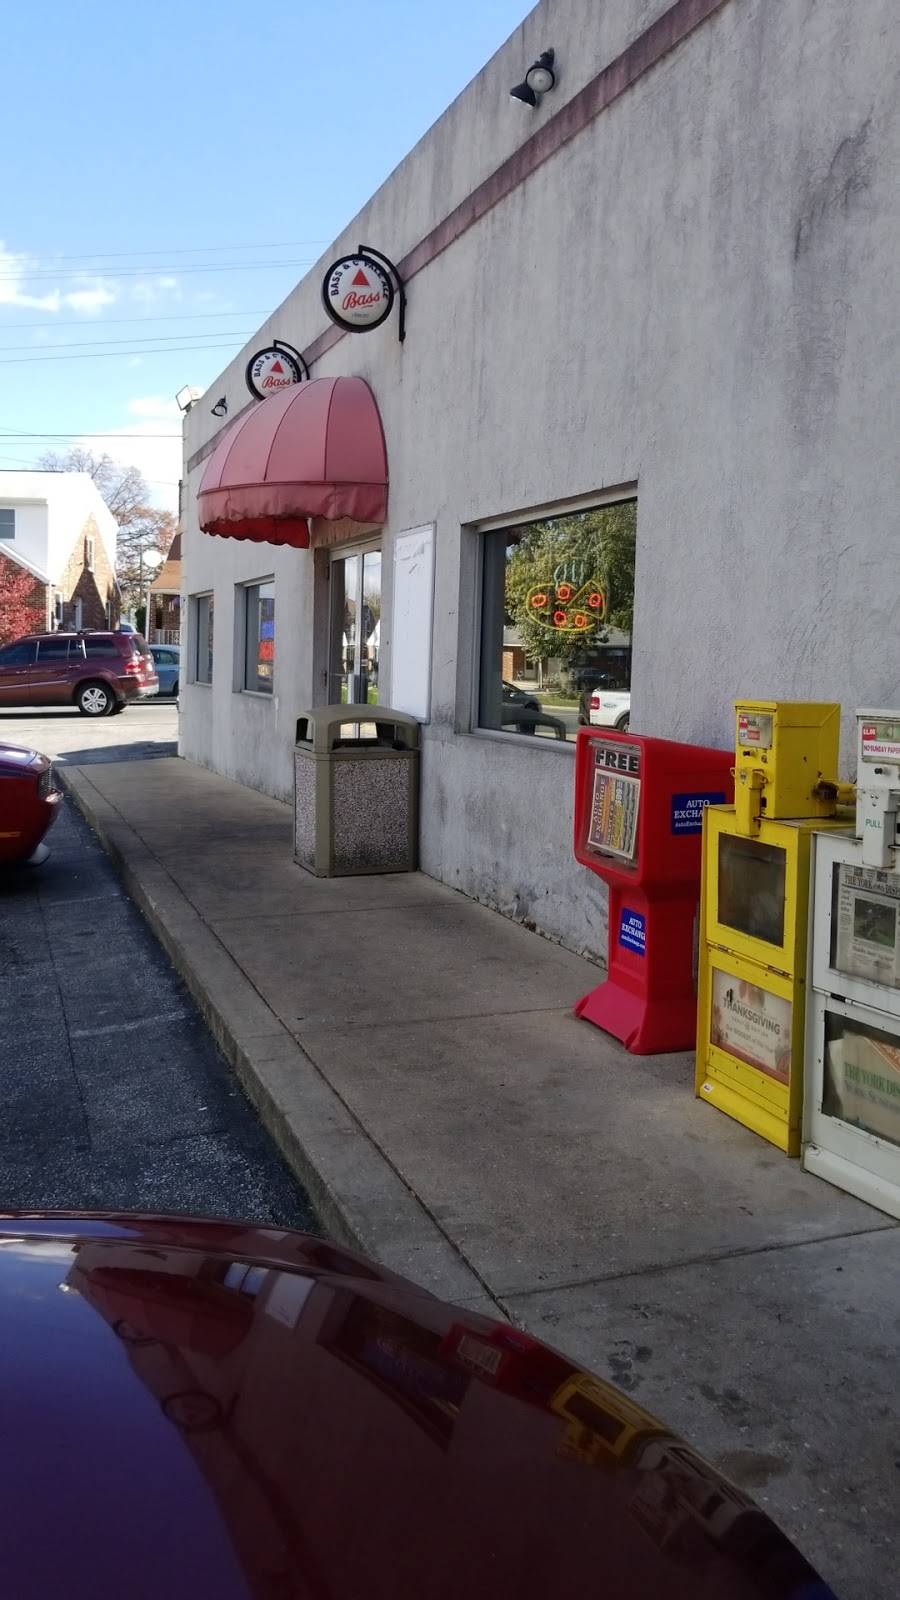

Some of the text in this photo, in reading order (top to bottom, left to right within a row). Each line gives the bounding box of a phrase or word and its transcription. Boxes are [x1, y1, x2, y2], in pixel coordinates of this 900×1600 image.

[331, 270, 343, 297] BASS
[342, 291, 380, 311] Bass
[262, 376, 291, 388] Bass
[596, 749, 640, 772] FREE
[686, 800, 710, 808] AUTO
[865, 819, 882, 828] PULL
[629, 917, 643, 929] AUTO
[723, 998, 781, 1035] THANKSGIVING
[844, 1062, 860, 1083] THE
